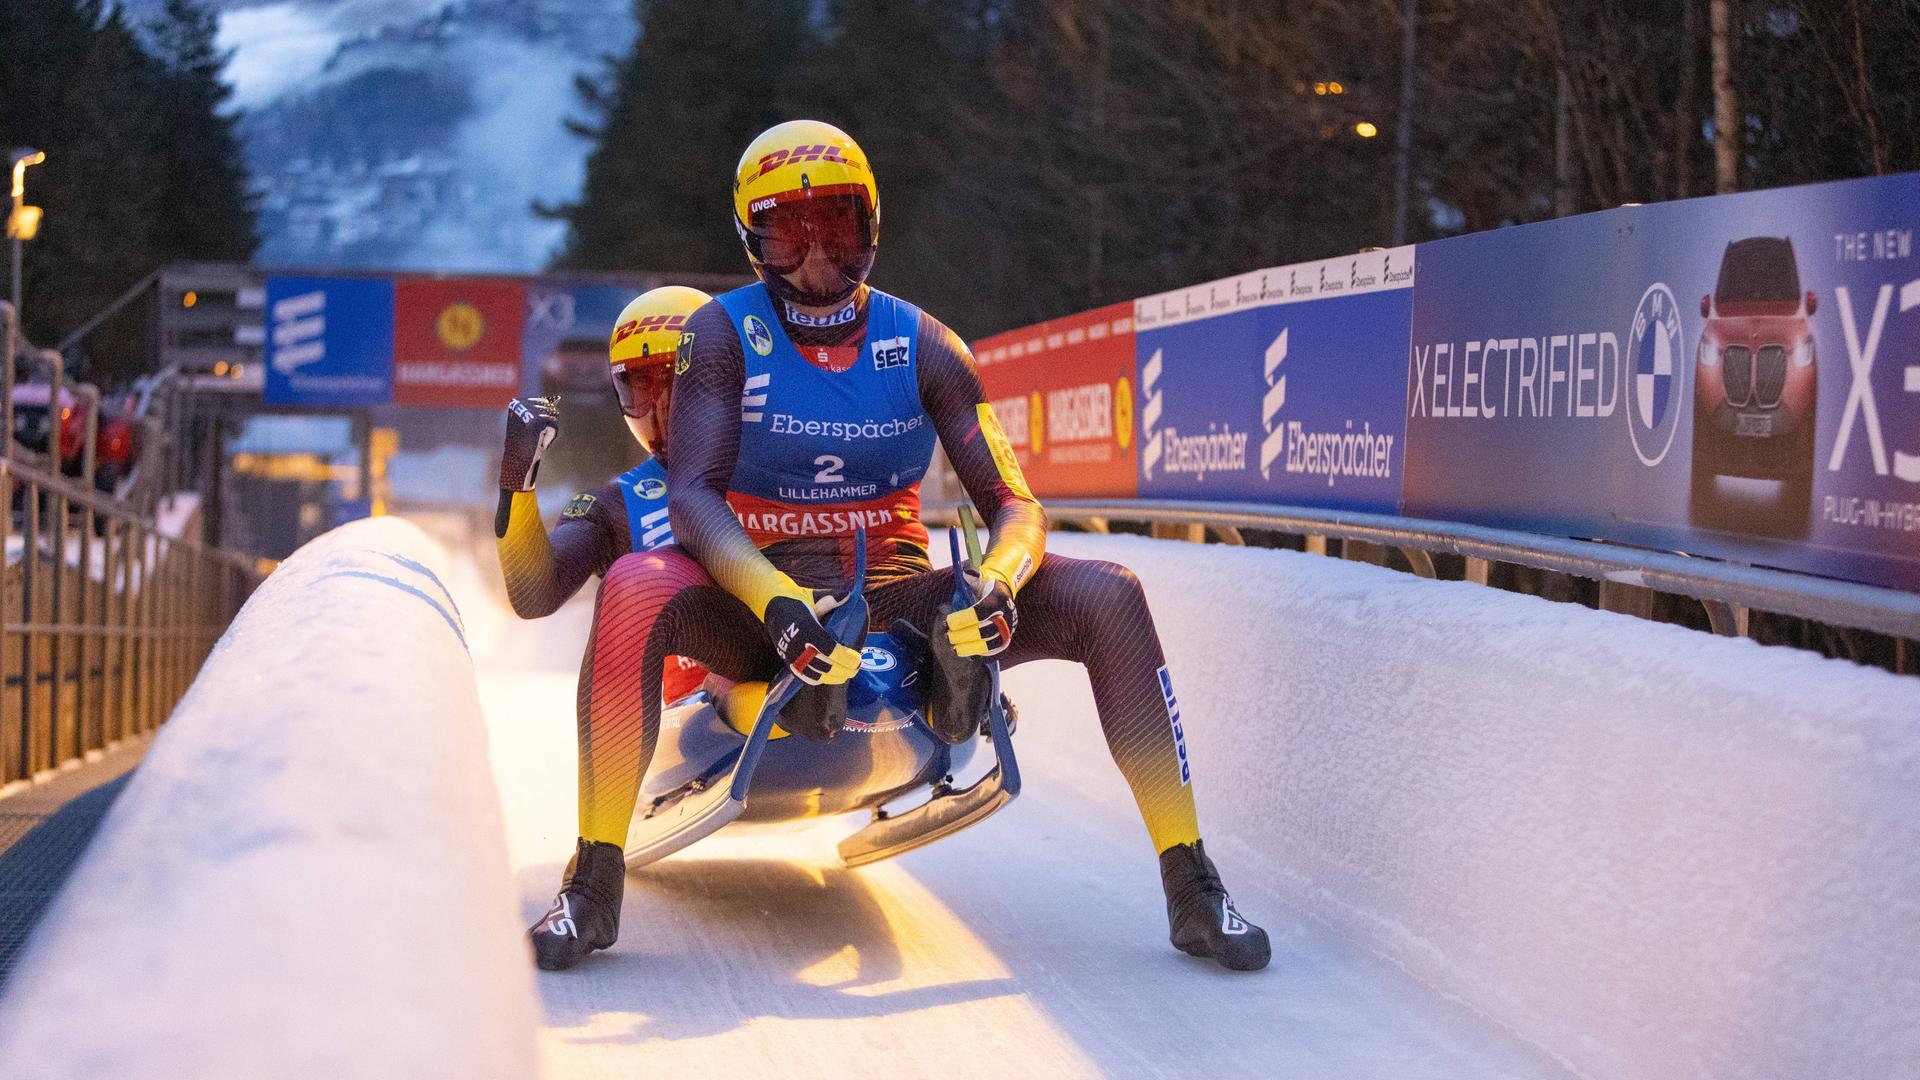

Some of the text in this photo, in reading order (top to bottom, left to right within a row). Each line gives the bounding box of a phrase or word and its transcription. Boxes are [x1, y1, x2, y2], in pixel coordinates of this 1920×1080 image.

[758, 144, 847, 177] DHL
[751, 197, 777, 213] uvex
[1834, 229, 1912, 261] THE NEW
[615, 315, 686, 344] DHL
[787, 304, 855, 327] teuto
[770, 414, 924, 441] Eberspächer
[1164, 422, 1248, 481] Eberspächer
[1286, 420, 1393, 487] Eberspächer
[813, 455, 845, 484] 2
[778, 484, 877, 500] LILLEHAMMER
[776, 622, 799, 660] SEIZ
[842, 721, 915, 734] NTINENTAL
[549, 893, 578, 939] TS
